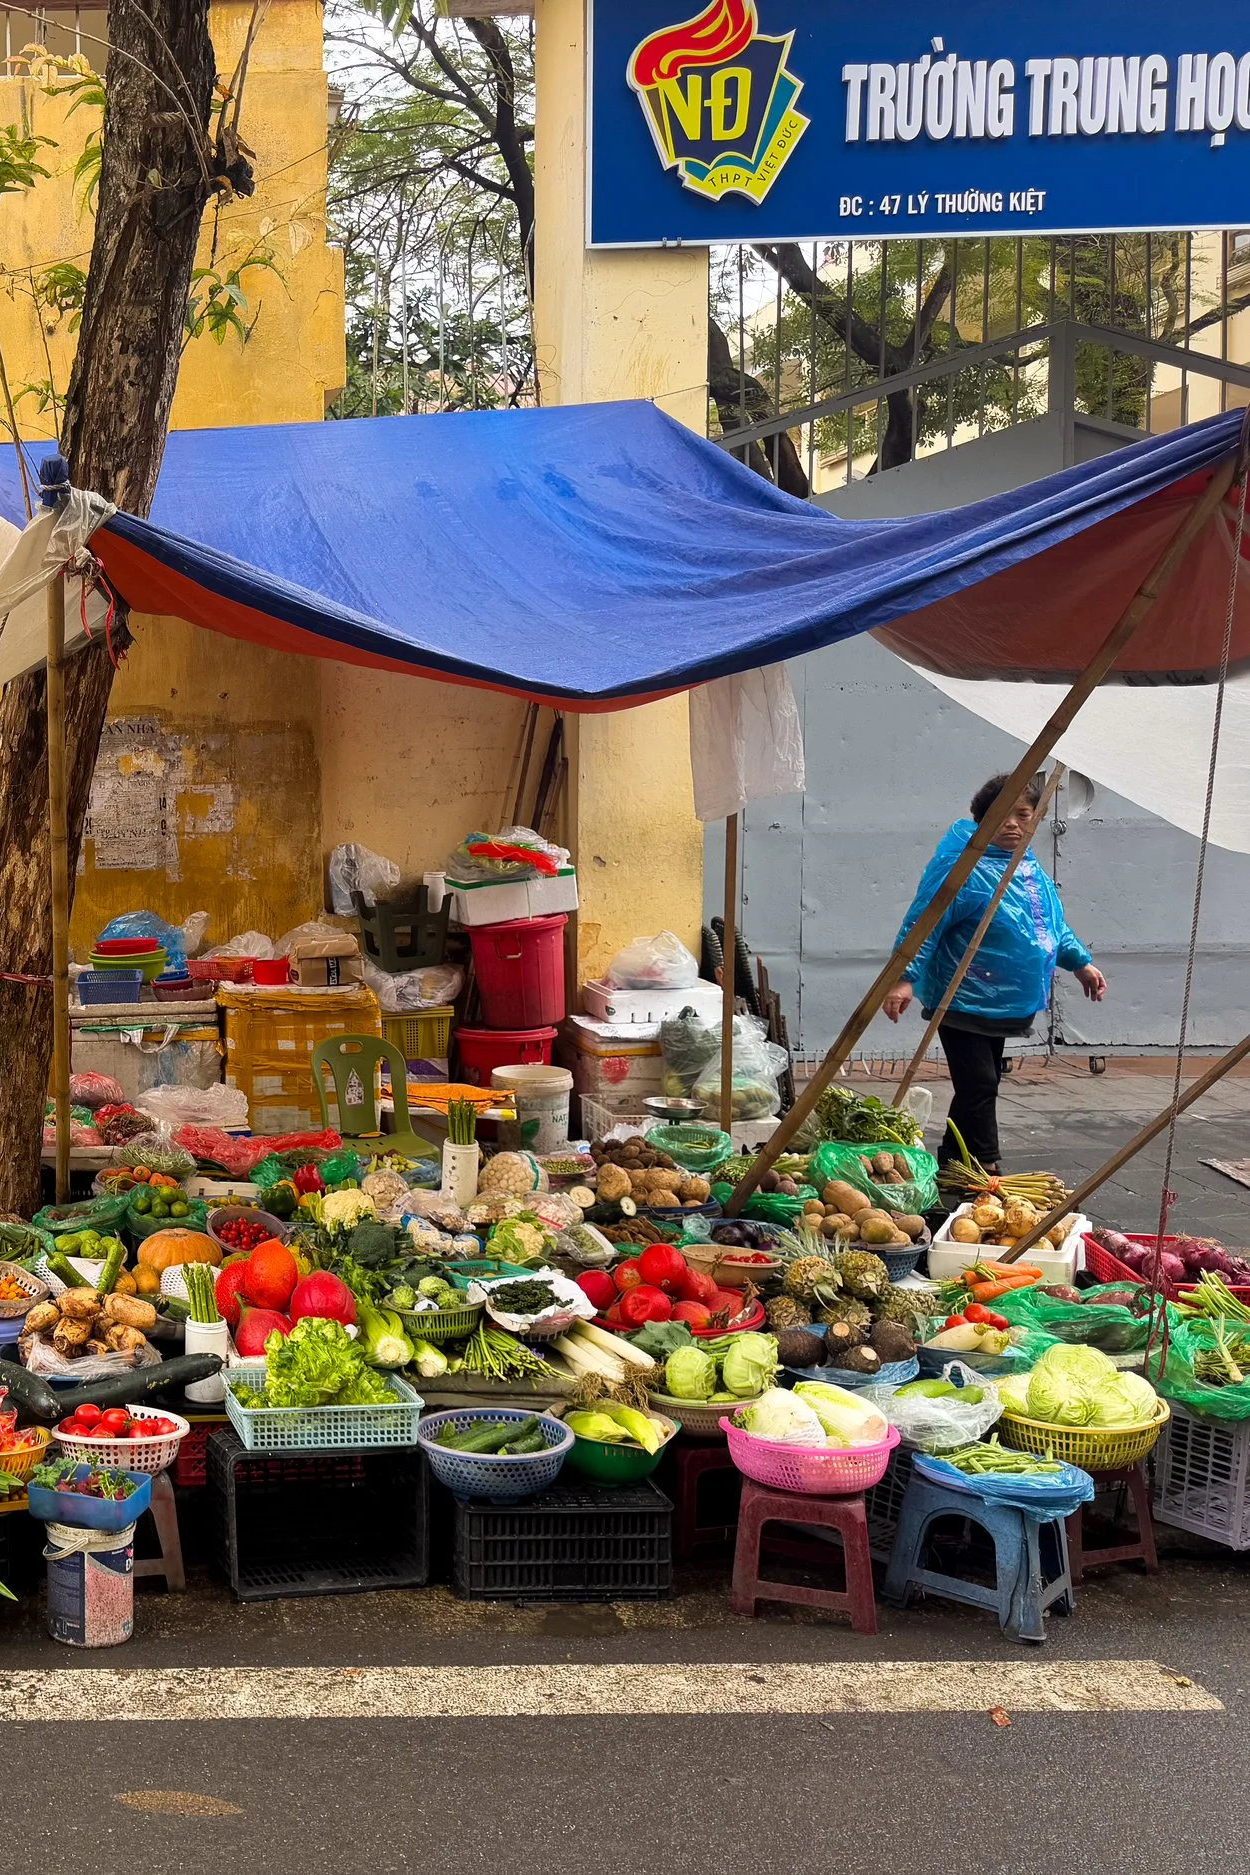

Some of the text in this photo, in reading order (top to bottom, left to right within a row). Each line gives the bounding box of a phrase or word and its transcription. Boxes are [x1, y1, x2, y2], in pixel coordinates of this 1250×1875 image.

[842, 37, 1015, 143] TRƯỜNG
[1025, 54, 1168, 136] TRUNG
[708, 120, 798, 188] THPT VIỆT ĐỨC
[839, 196, 863, 216] ĐC
[879, 195, 901, 215] 47
[907, 190, 929, 215] LÝ
[934, 188, 1003, 214] THƯỜNG
[1009, 187, 1047, 215] KIỆT
